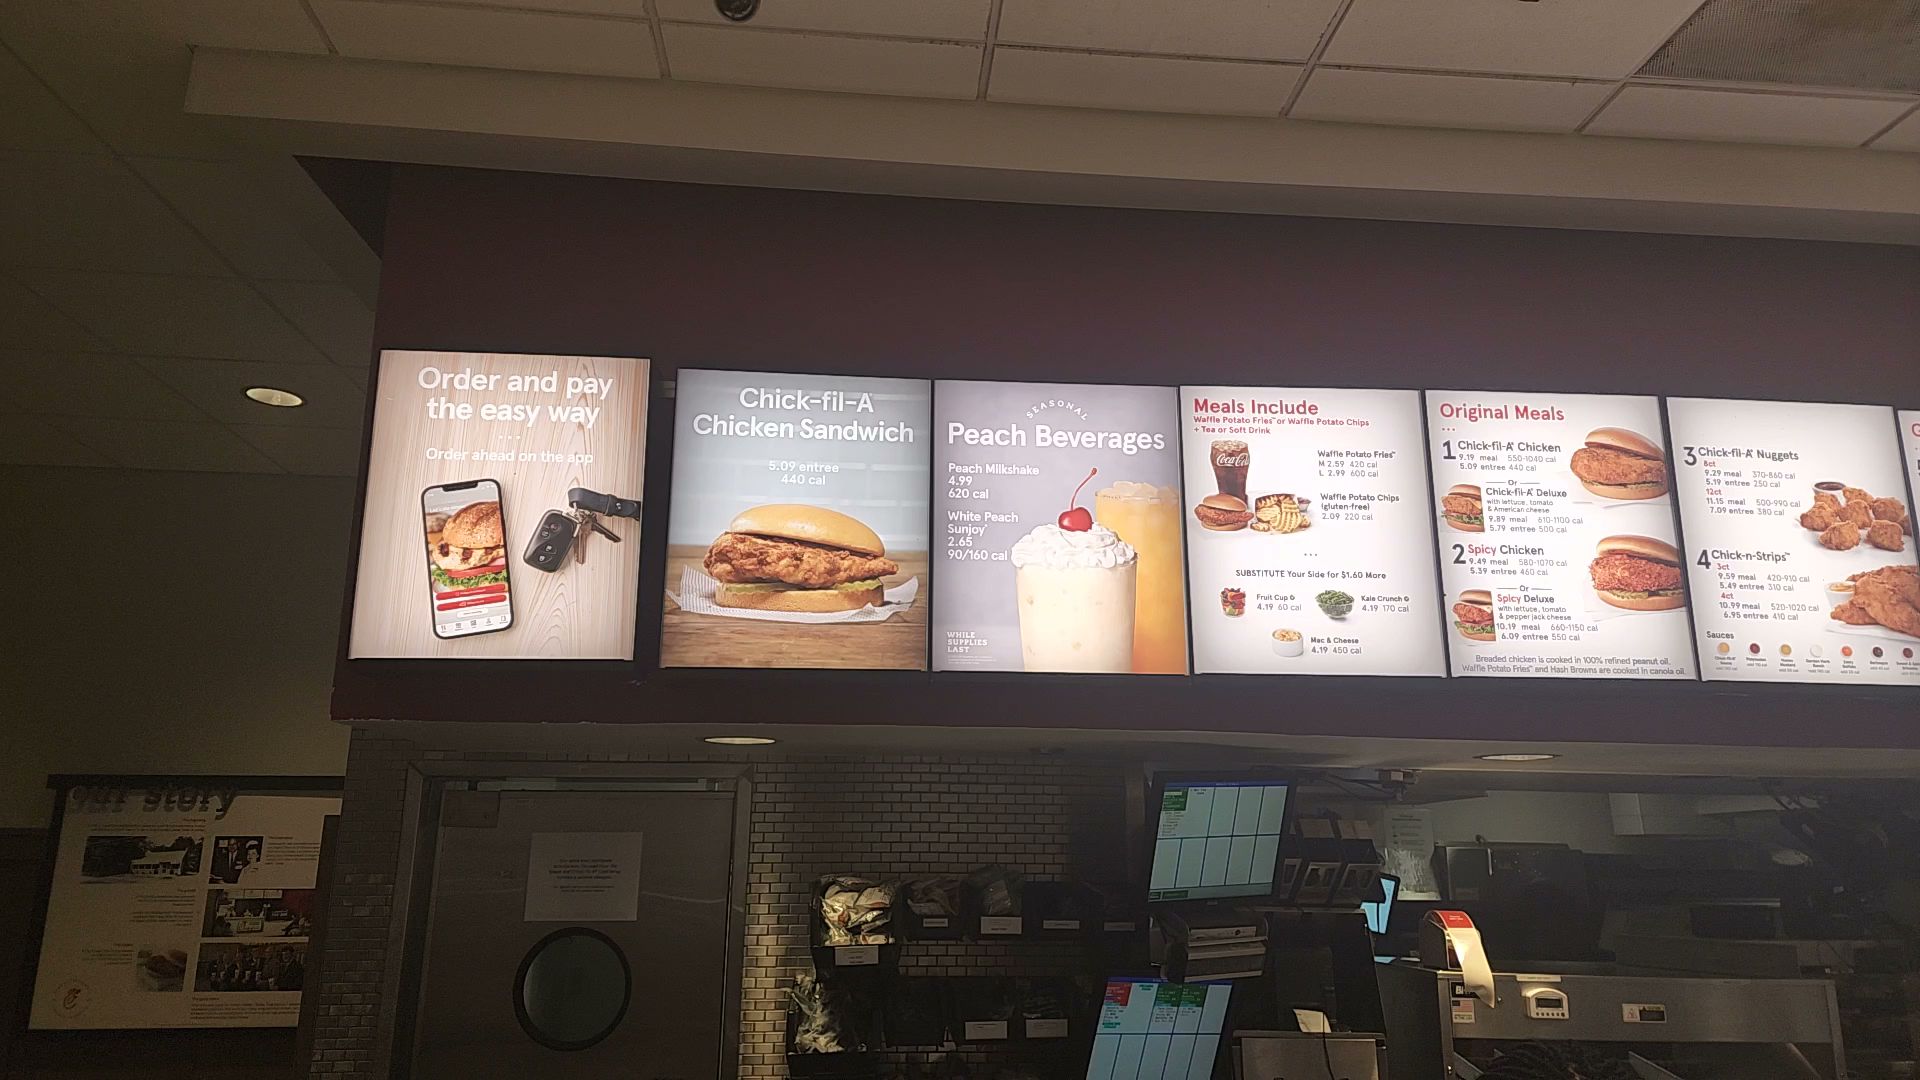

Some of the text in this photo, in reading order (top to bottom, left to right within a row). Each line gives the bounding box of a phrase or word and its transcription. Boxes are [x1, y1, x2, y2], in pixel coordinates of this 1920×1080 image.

[418, 367, 613, 400] Order and pay
[1025, 399, 1089, 421] SEASONAL
[1193, 398, 1318, 415] Meals Include
[427, 397, 600, 428] the easy way
[1440, 403, 1565, 422] Original Meals
[1193, 416, 1221, 424] Waffle
[1347, 419, 1369, 427] Chips
[693, 414, 914, 443] Chicken Sandwich
[948, 422, 1165, 455] Peach Beverages
[1442, 440, 1456, 460] 1
[1518, 443, 1561, 453] Chicken
[426, 448, 593, 465] Order ahead on the app
[1318, 450, 1343, 458] Waffle
[1683, 447, 1697, 466] 3
[1757, 450, 1799, 461] Nuggets
[768, 460, 840, 486] 5.09 entree 440 cal
[949, 463, 1040, 475] Peach Milkshake
[948, 476, 973, 486] 4.99
[948, 488, 989, 499] 620 cal
[1536, 488, 1567, 498] Deluxe
[1706, 488, 1722, 496] 12ct
[1320, 493, 1400, 503] Waffle Potato Chips
[1321, 502, 1370, 511] (gluten-free)
[948, 511, 1019, 523] White Peach
[948, 537, 973, 547] 2.65
[948, 550, 1008, 561] 90/160 cal
[1453, 544, 1467, 565] 2
[1468, 544, 1544, 556] Spicy Chicken
[1556, 559, 1568, 567] cal
[1697, 550, 1711, 570] 4
[1717, 563, 1730, 571] 3ct
[1236, 569, 1285, 578] SUBSTITUTE
[1327, 571, 1339, 579] for
[1341, 571, 1363, 580] $1.60
[1497, 594, 1555, 604] Spicy Deluxe
[1721, 592, 1734, 600] 4ct
[1362, 604, 1378, 612] 4.19
[1771, 603, 1806, 611] 520-1020
[1808, 604, 1820, 612] cal
[1531, 614, 1546, 622] jack
[1773, 612, 1786, 620] 410
[1706, 631, 1734, 639] Sauces
[948, 638, 988, 646] SUPPLIES
[1476, 655, 1507, 663] Breaded
[1546, 656, 1573, 664] cooked
[1605, 657, 1631, 665] refined
[1632, 657, 1658, 666] peanut
